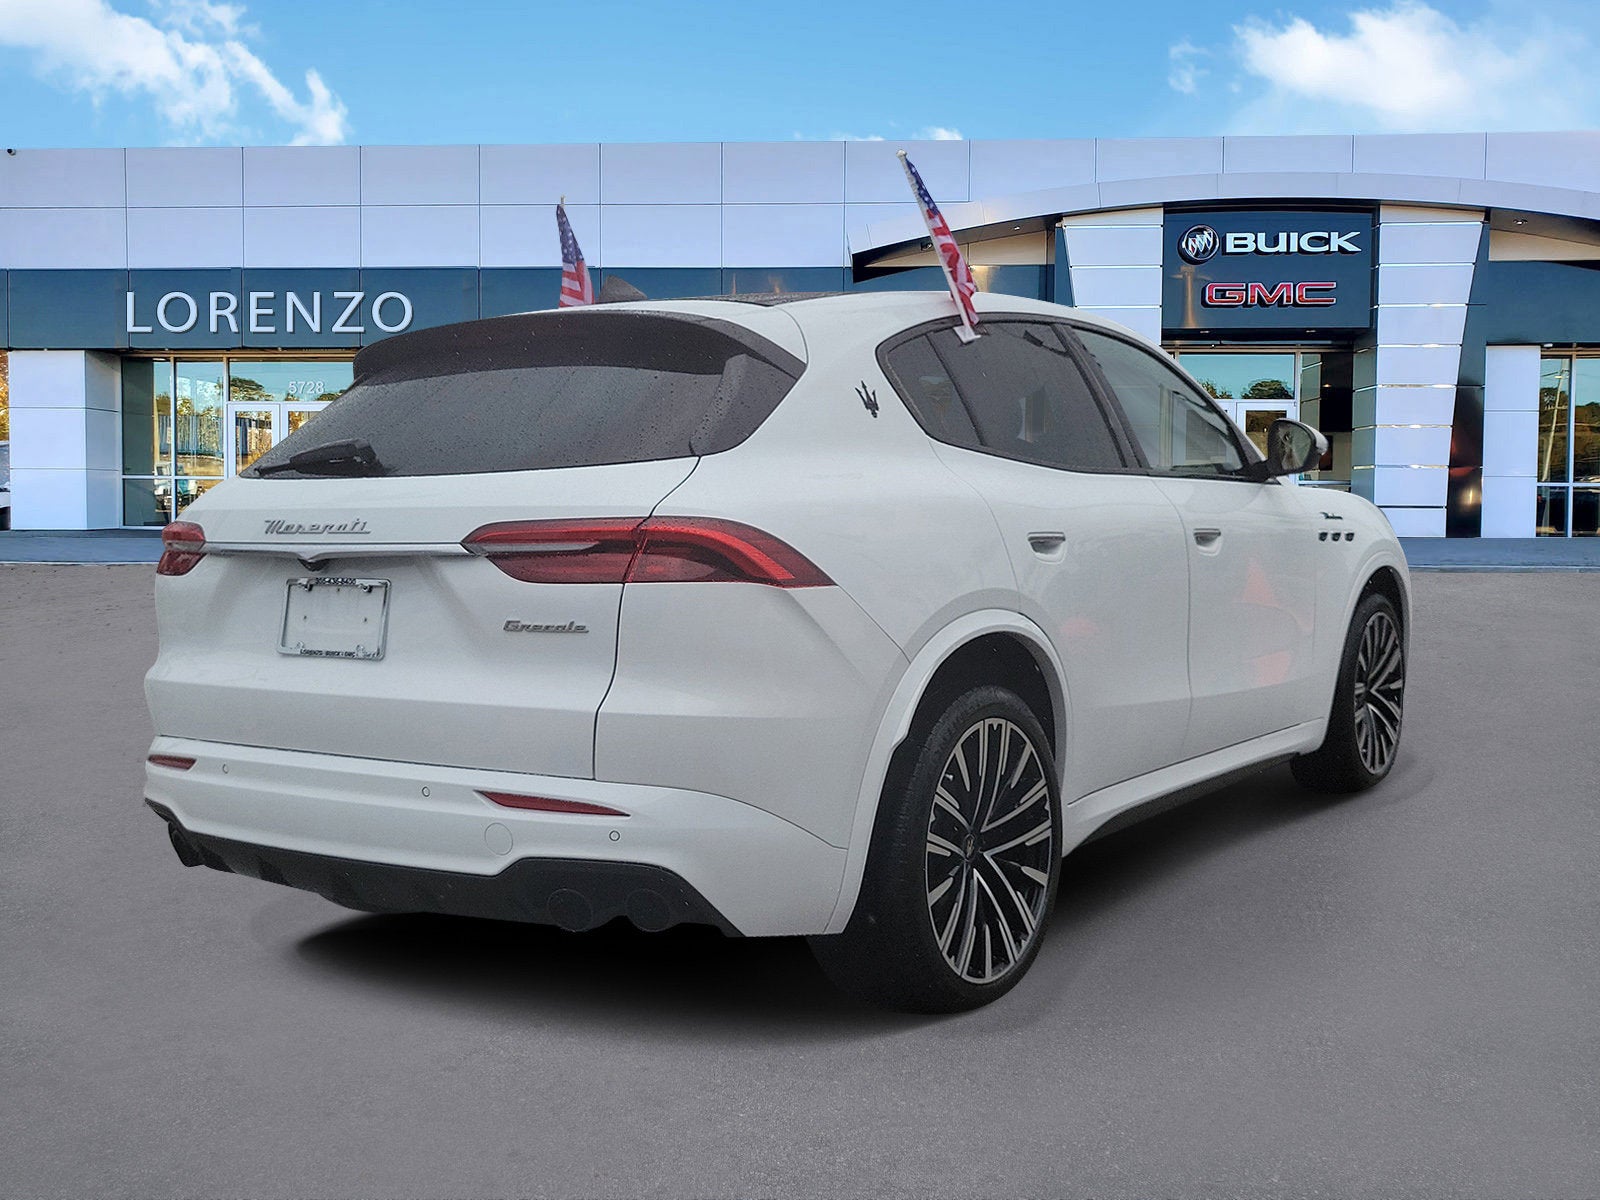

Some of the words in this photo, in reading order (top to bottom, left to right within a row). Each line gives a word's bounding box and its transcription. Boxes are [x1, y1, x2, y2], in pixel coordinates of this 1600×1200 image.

[1225, 231, 1362, 253] BUICK
[1205, 281, 1337, 305] GMC
[126, 291, 414, 333] LORENZO
[288, 380, 325, 394] 5728
[264, 518, 371, 534] Maserati
[503, 620, 589, 633] Grecale
